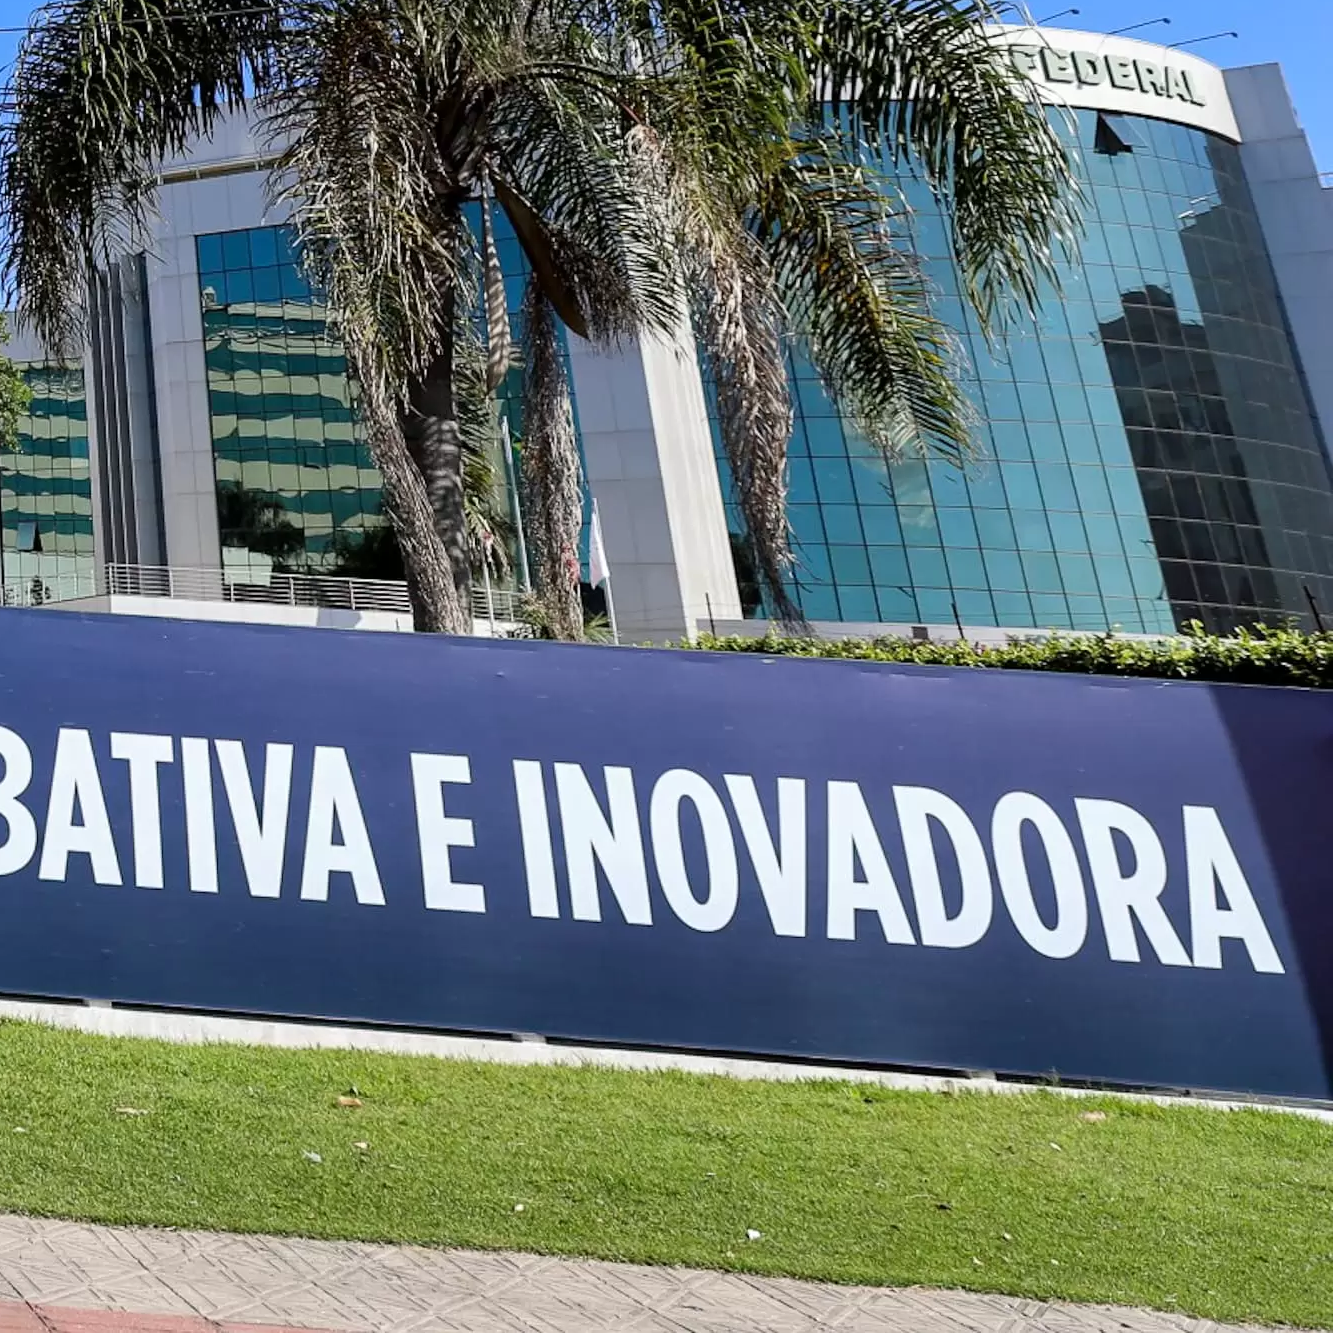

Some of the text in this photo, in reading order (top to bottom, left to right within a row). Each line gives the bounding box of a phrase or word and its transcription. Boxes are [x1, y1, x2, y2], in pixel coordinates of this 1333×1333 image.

[1009, 44, 1205, 107] FEDERAL
[411, 752, 485, 914] E
[513, 759, 1286, 974] INOVADORA
